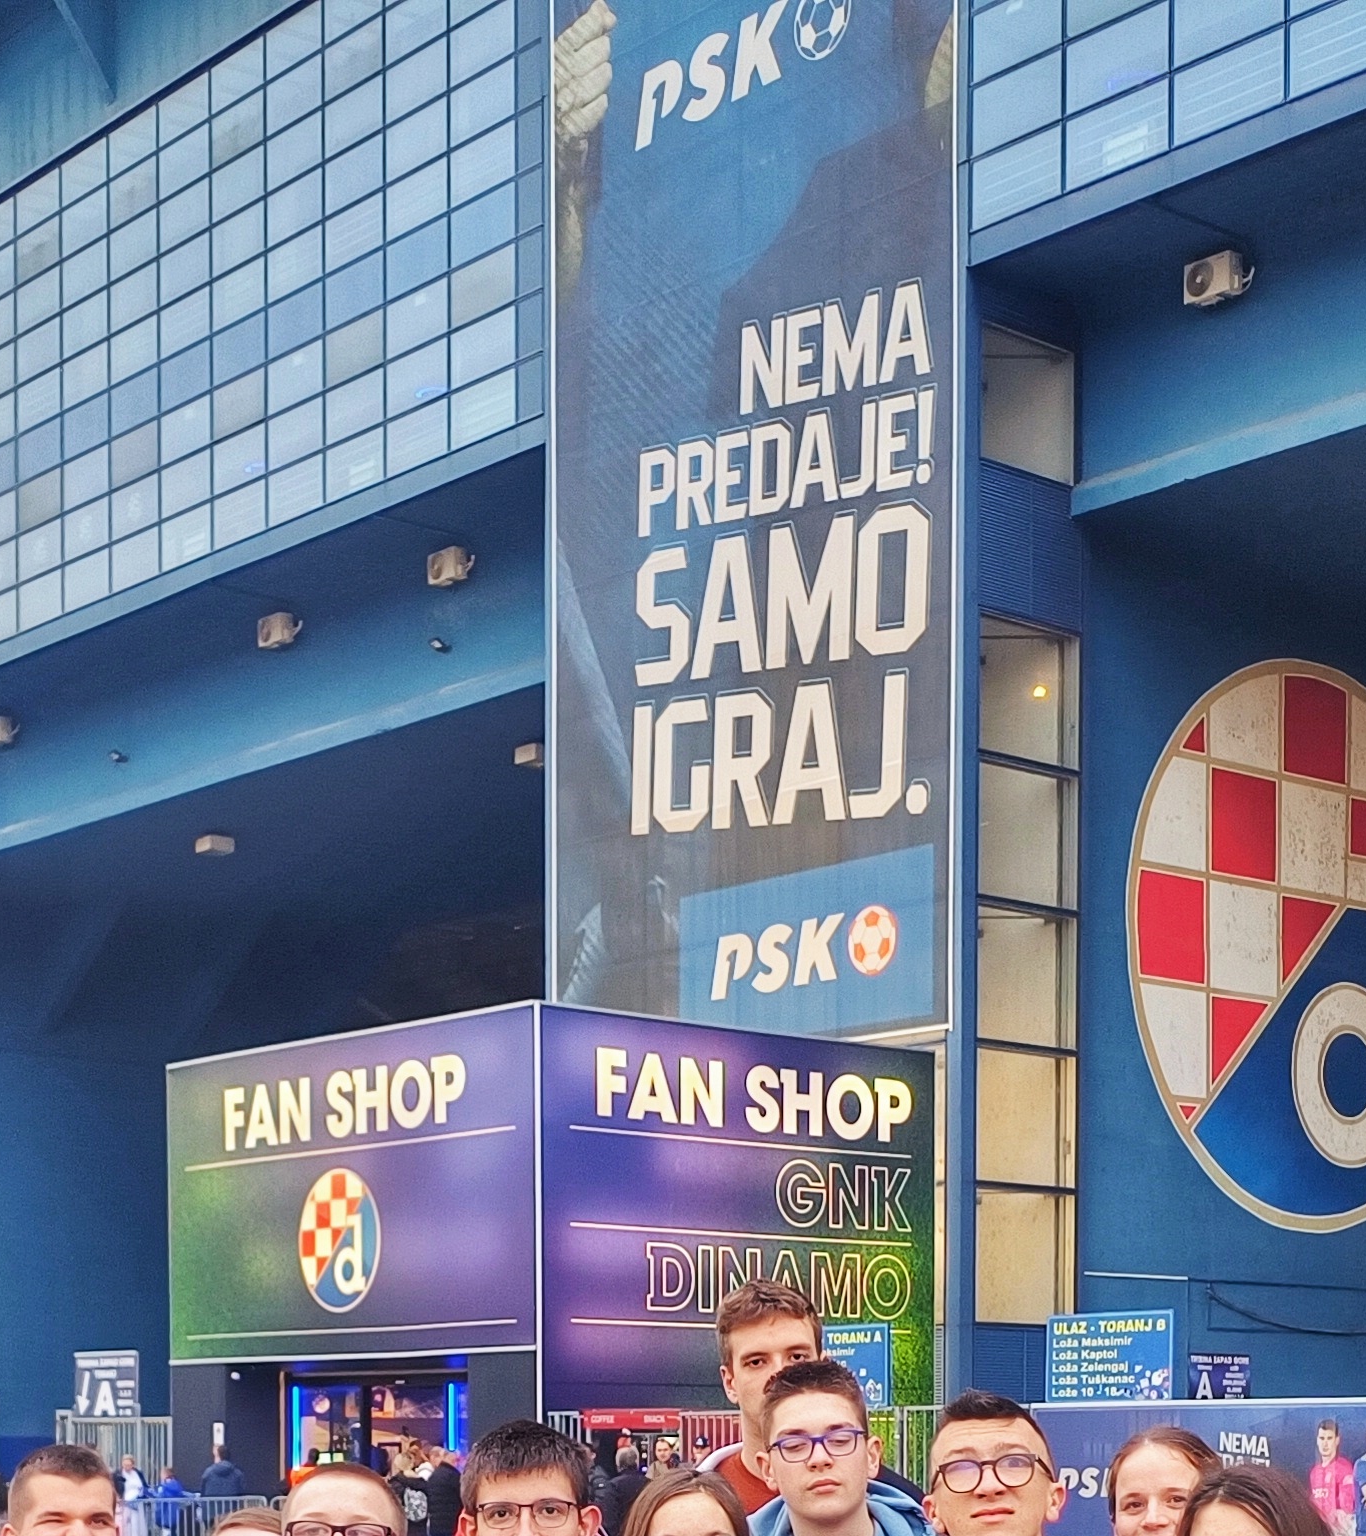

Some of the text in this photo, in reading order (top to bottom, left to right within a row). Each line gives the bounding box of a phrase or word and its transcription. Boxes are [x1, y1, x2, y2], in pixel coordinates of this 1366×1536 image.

[635, 0, 788, 151] PSK
[740, 279, 932, 415] NEMA
[637, 385, 937, 537] PREDAJE!
[635, 500, 932, 686] SAMO
[631, 669, 931, 835] IGRAJ.
[711, 913, 845, 1000] PSK
[223, 1054, 466, 1151] FAN SHOP
[595, 1047, 912, 1142] FAN SHOP
[775, 1158, 912, 1233] GNK
[646, 1242, 911, 1321] DINAMO
[827, 1331, 882, 1345] TORANJ A
[1052, 1336, 1133, 1348] Loža Maksimir
[1053, 1321, 1088, 1335] ULAZ
[1098, 1319, 1152, 1333] TORANJ
[1052, 1349, 1118, 1361] Loža Kaptol
[1052, 1361, 1129, 1373] Loža Zelengaj
[1052, 1374, 1135, 1385] Loža Tuškanac
[1052, 1386, 1078, 1397] Lože
[1081, 1387, 1094, 1397] 10
[1195, 1371, 1213, 1399] A
[94, 1380, 117, 1416] A
[1219, 1431, 1270, 1457] NEMA
[1059, 1467, 1111, 1498] PS
